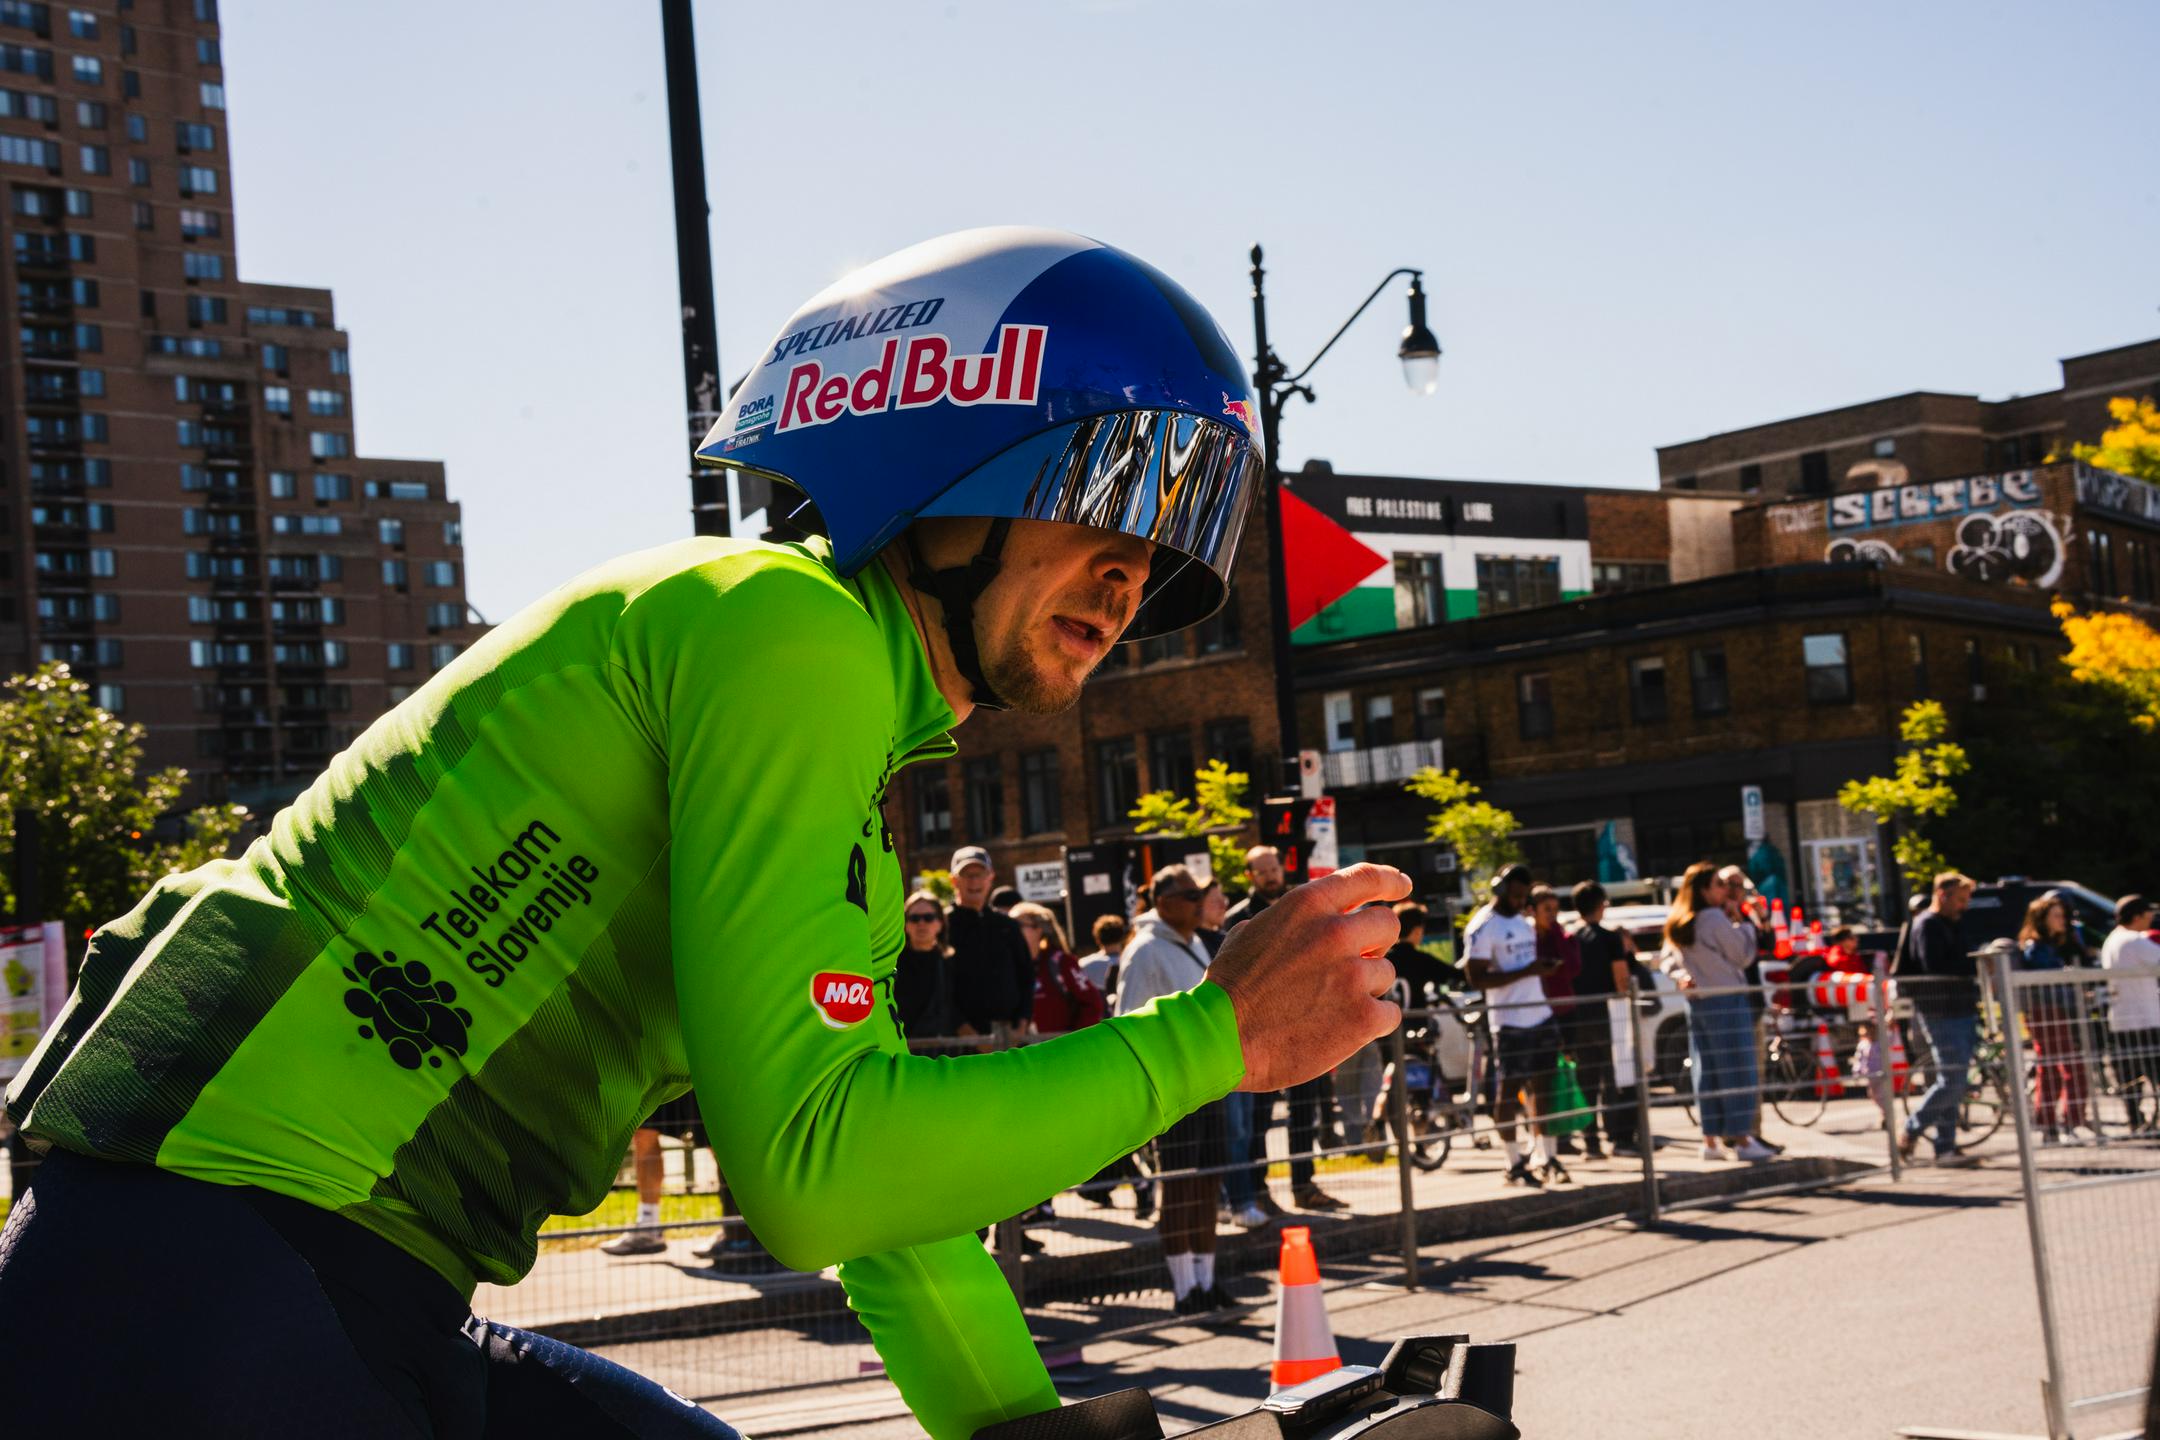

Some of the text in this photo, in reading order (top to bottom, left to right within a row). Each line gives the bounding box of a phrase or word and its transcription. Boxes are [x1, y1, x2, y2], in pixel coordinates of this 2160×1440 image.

[764, 297, 945, 367] SPECIALIZED
[777, 326, 1045, 431] Red Bull
[736, 411, 771, 427] hansgrohe
[738, 394, 774, 418] BORA
[735, 433, 760, 448] TRATNIK
[420, 820, 561, 950] Telekom
[466, 855, 599, 988] Slovenije
[823, 982, 870, 1006] MOL
